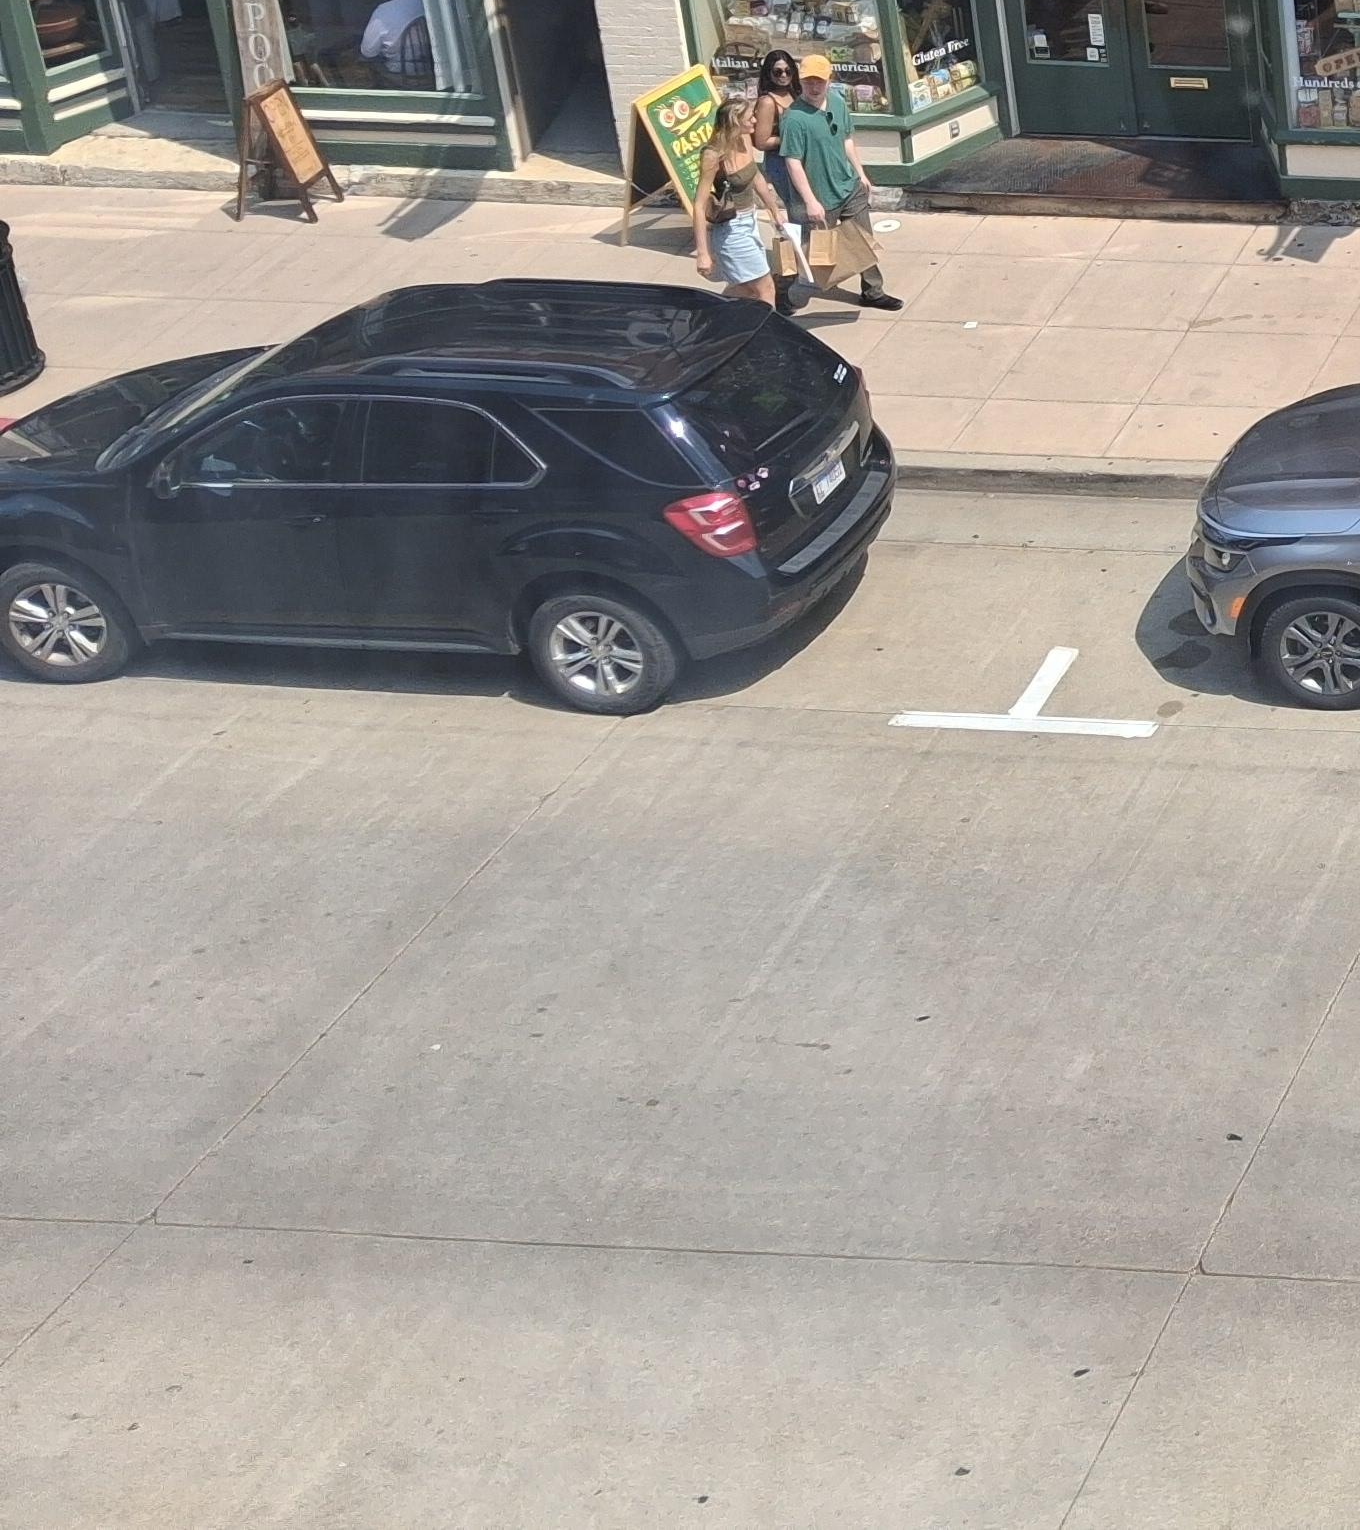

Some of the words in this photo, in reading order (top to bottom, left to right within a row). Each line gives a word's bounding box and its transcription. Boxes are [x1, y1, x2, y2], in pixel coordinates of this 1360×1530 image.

[911, 46, 947, 67] Gluten
[948, 37, 970, 53] Free
[711, 56, 750, 69] Italian
[831, 62, 879, 74] merican
[1293, 76, 1354, 90] Hundreds
[671, 121, 713, 158] PASTA
